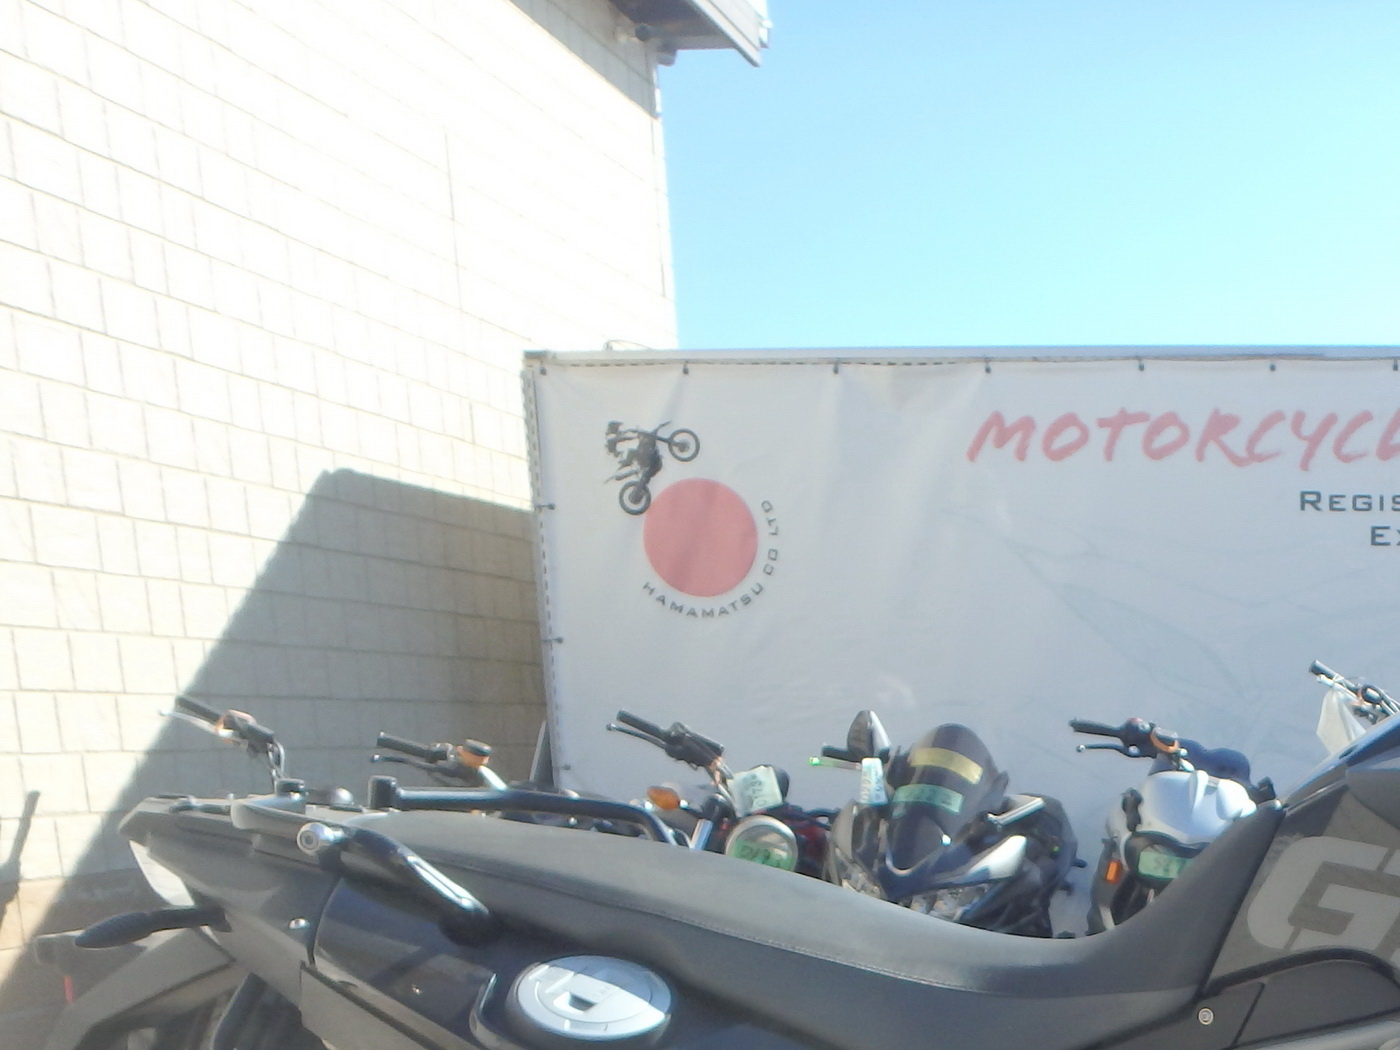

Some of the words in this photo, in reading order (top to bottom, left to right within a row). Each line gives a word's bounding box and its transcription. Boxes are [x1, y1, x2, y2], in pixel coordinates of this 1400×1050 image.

[760, 500, 780, 536] LTD
[762, 548, 779, 576] CO
[642, 581, 764, 618] HAMAMATSU
